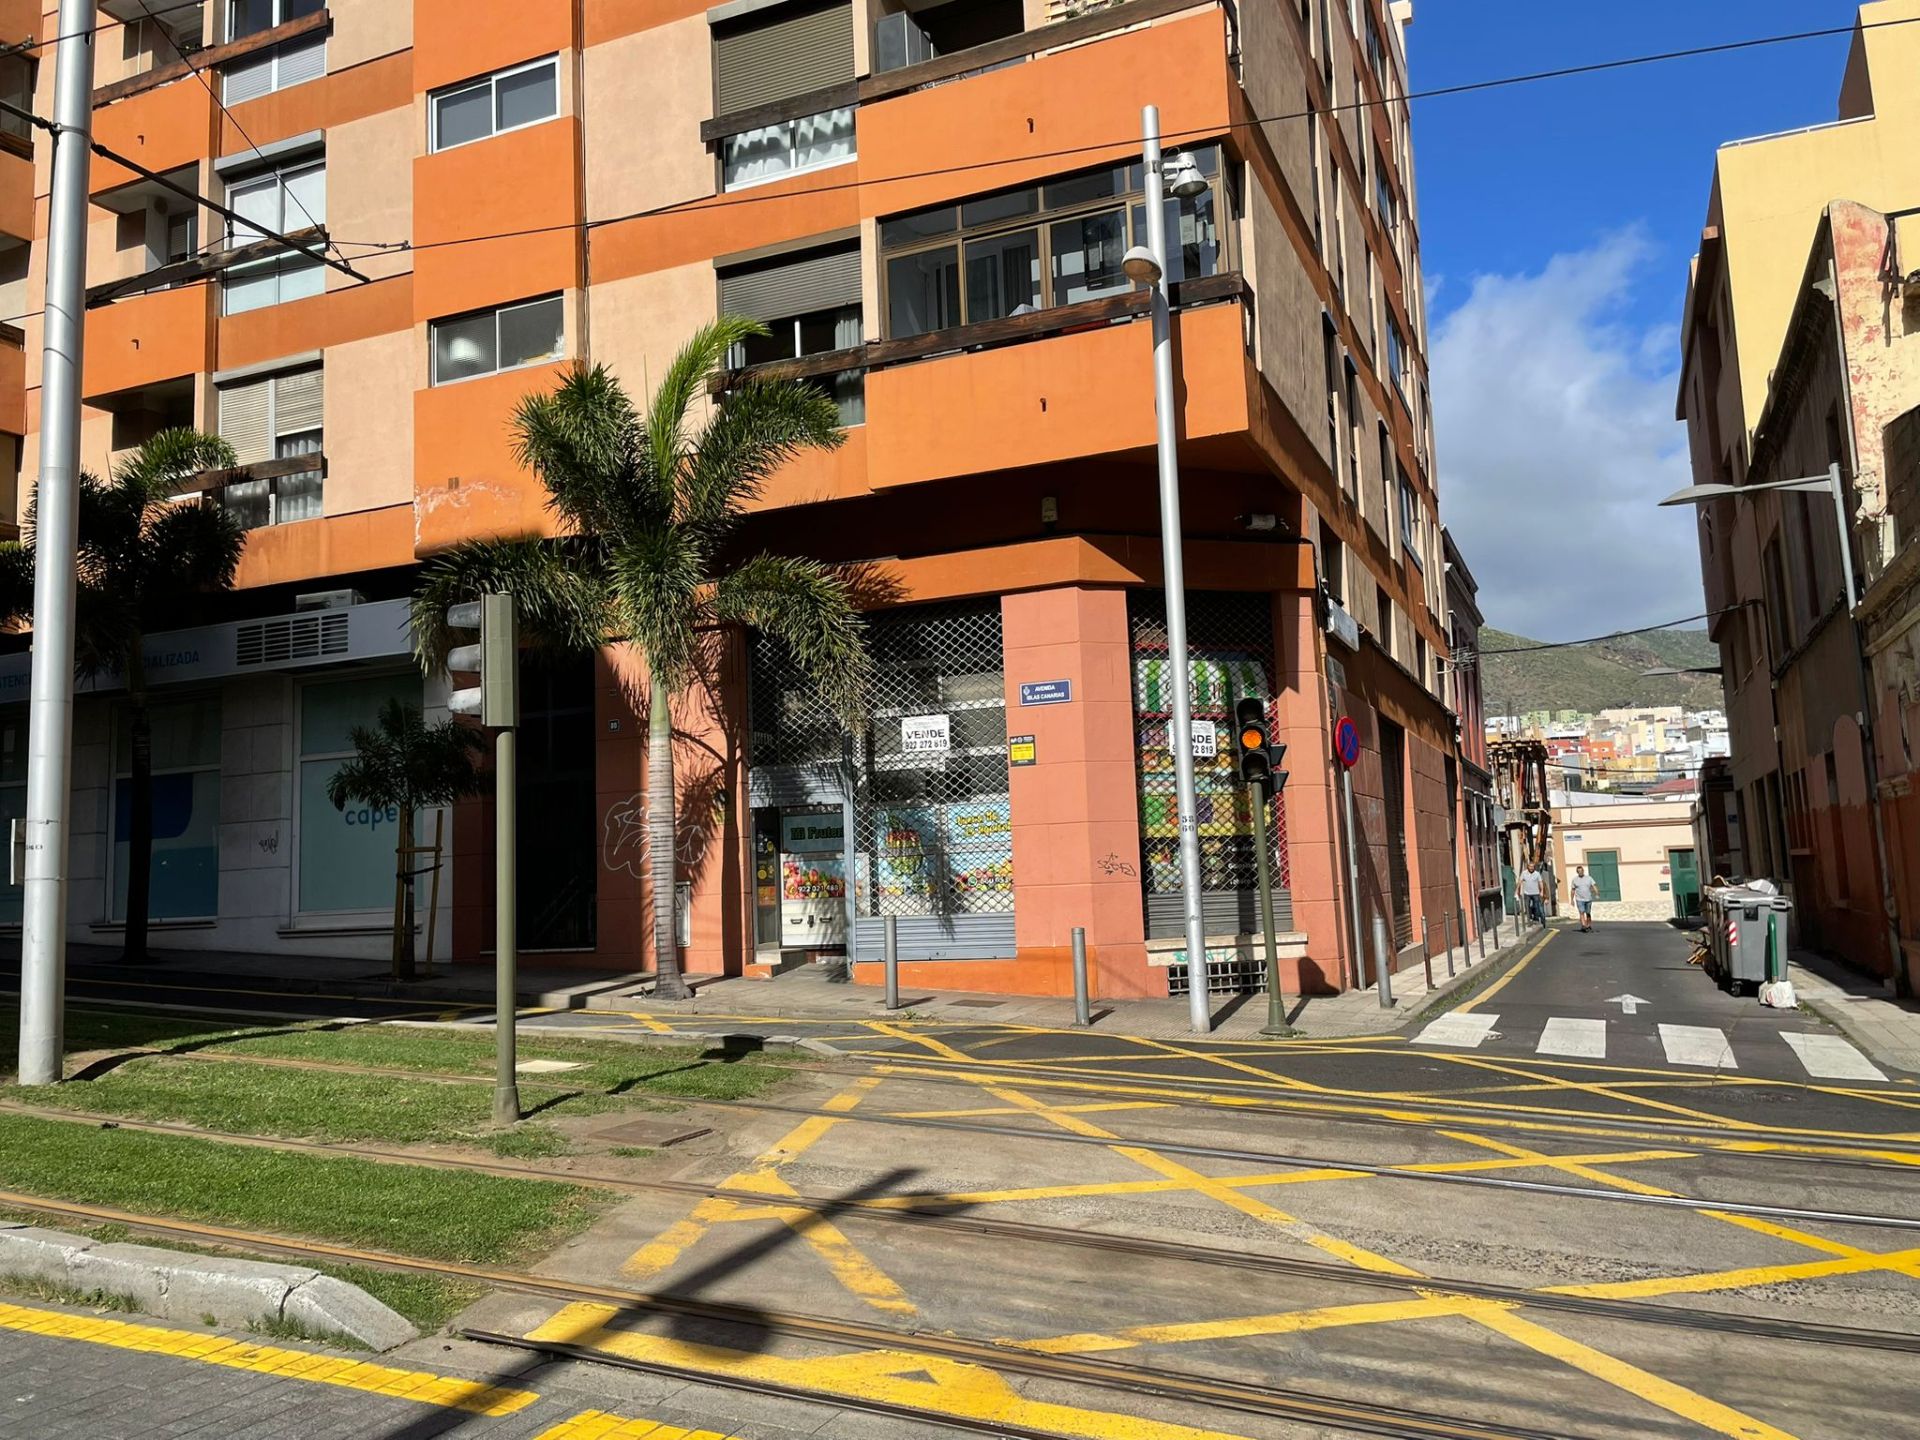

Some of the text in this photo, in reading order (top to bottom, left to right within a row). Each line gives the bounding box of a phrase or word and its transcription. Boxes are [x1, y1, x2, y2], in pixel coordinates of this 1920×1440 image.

[1040, 692, 1065, 700] CANARIAS
[906, 729, 945, 739] VENDE
[1192, 734, 1212, 744] NDE
[905, 741, 917, 749] 922
[920, 740, 932, 748] 272
[1201, 745, 1213, 754] 819
